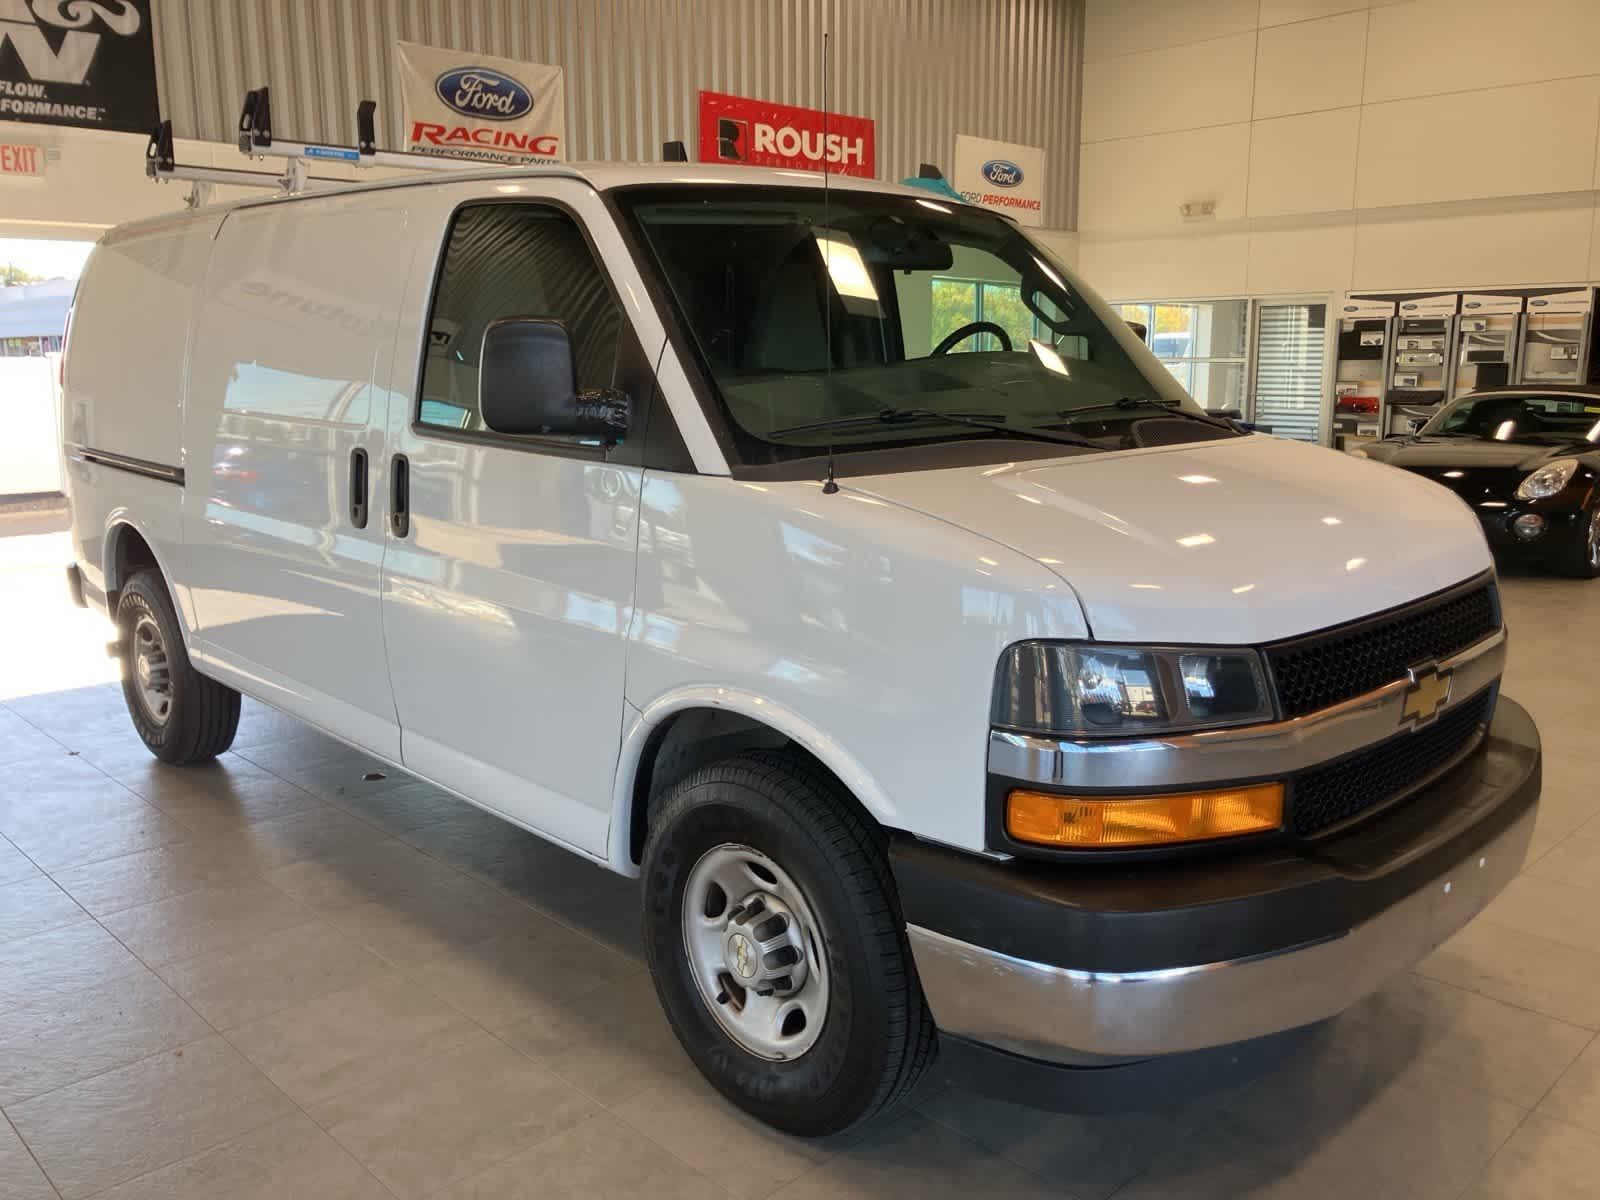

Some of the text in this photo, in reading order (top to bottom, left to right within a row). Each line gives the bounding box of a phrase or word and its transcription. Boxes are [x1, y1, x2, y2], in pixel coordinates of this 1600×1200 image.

[455, 74, 516, 113] Ford
[411, 121, 559, 156] RACING
[754, 123, 863, 166] ROUSH
[1, 145, 37, 173] EXIT
[411, 145, 515, 162] PERFORMANCE
[989, 163, 1016, 183] Ford
[982, 194, 1041, 211] PERFORMANCE
